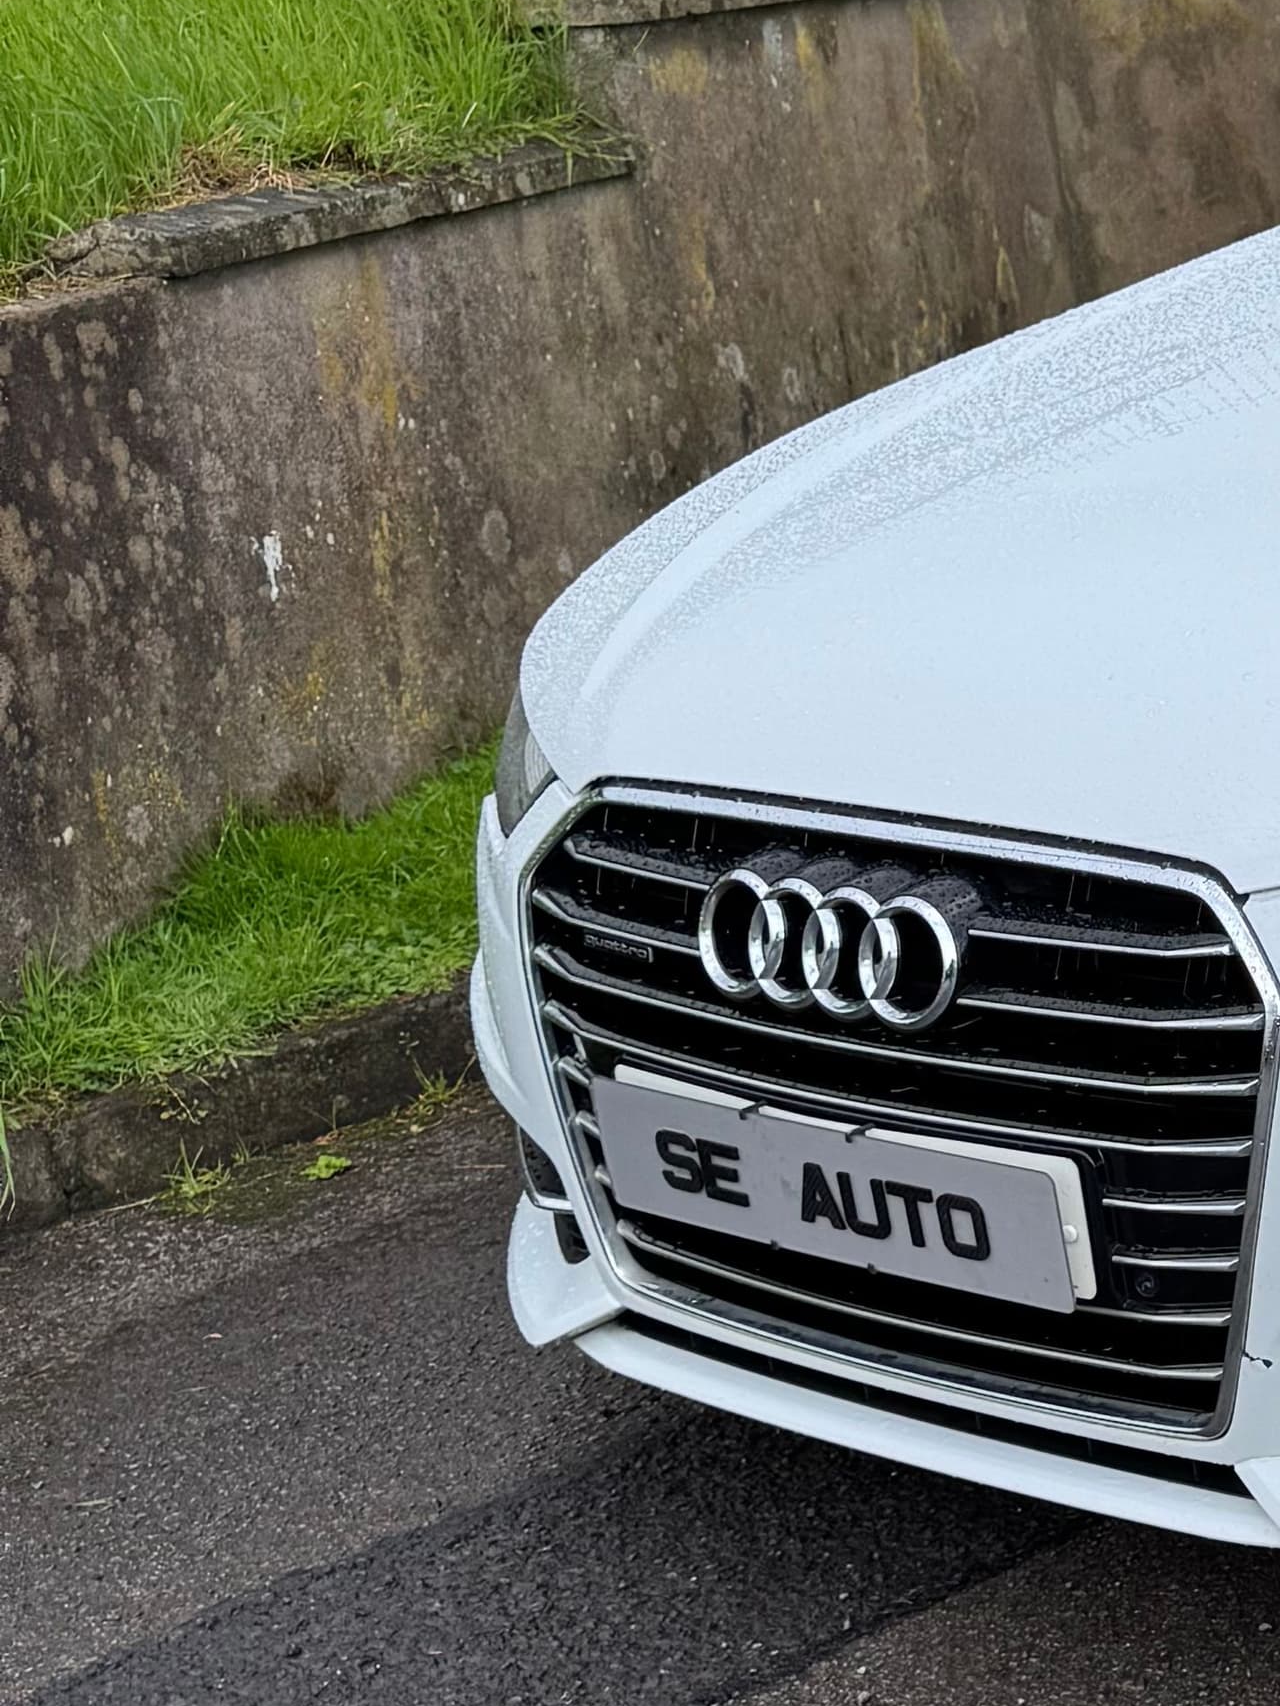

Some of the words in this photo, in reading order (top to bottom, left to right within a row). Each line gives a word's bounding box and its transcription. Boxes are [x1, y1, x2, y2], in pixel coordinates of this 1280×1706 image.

[583, 934, 649, 960] quattro
[655, 1127, 751, 1208] SE
[801, 1161, 992, 1261] AUTO
